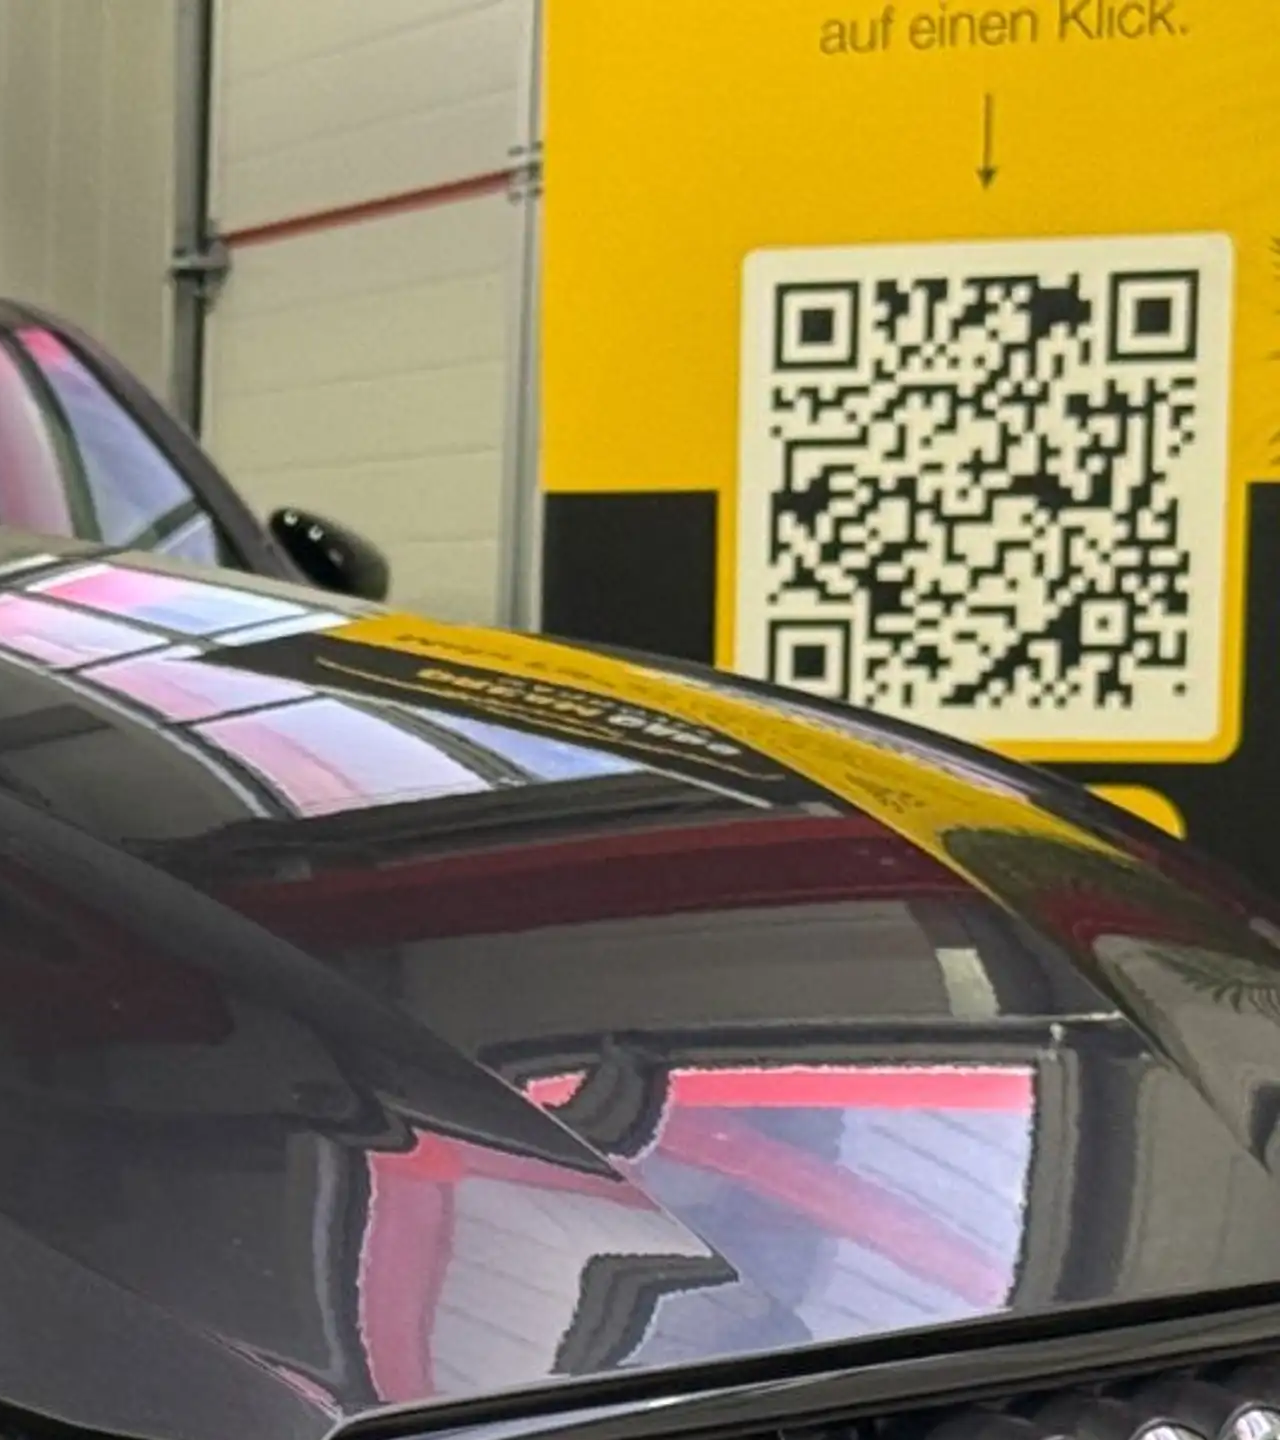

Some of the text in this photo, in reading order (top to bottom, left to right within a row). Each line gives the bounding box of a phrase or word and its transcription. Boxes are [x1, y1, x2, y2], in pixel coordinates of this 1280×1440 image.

[819, 0, 1190, 55] auf einen Klick.
